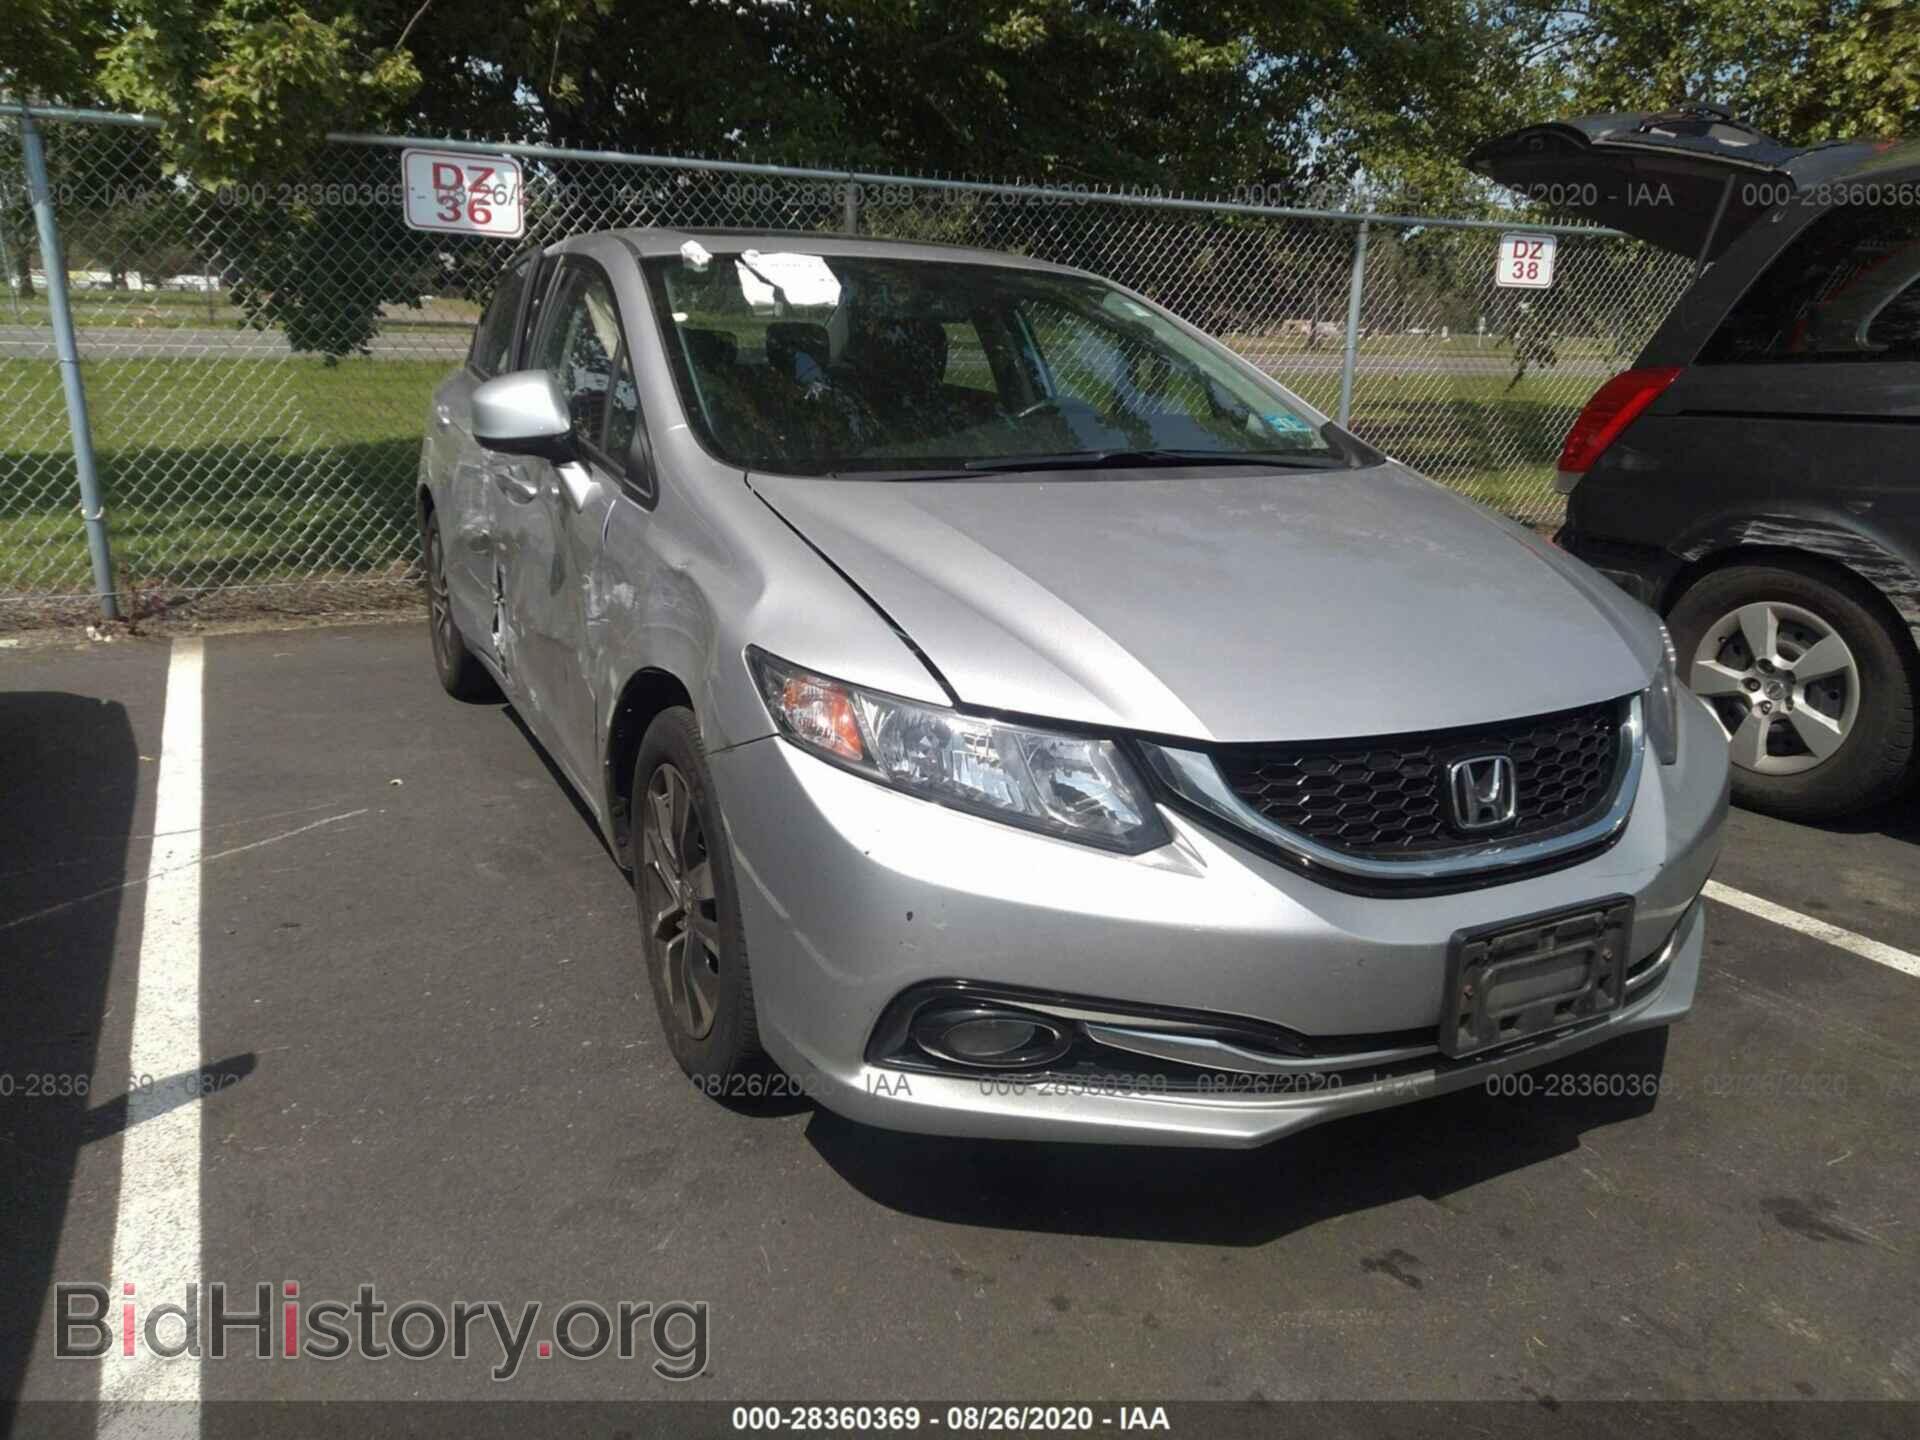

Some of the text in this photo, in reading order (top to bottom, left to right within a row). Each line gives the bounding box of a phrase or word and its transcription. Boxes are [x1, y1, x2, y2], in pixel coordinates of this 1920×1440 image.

[432, 162, 495, 193] DZ
[437, 196, 492, 224] 36
[1512, 240, 1544, 259] DZ
[1512, 261, 1538, 279] 38
